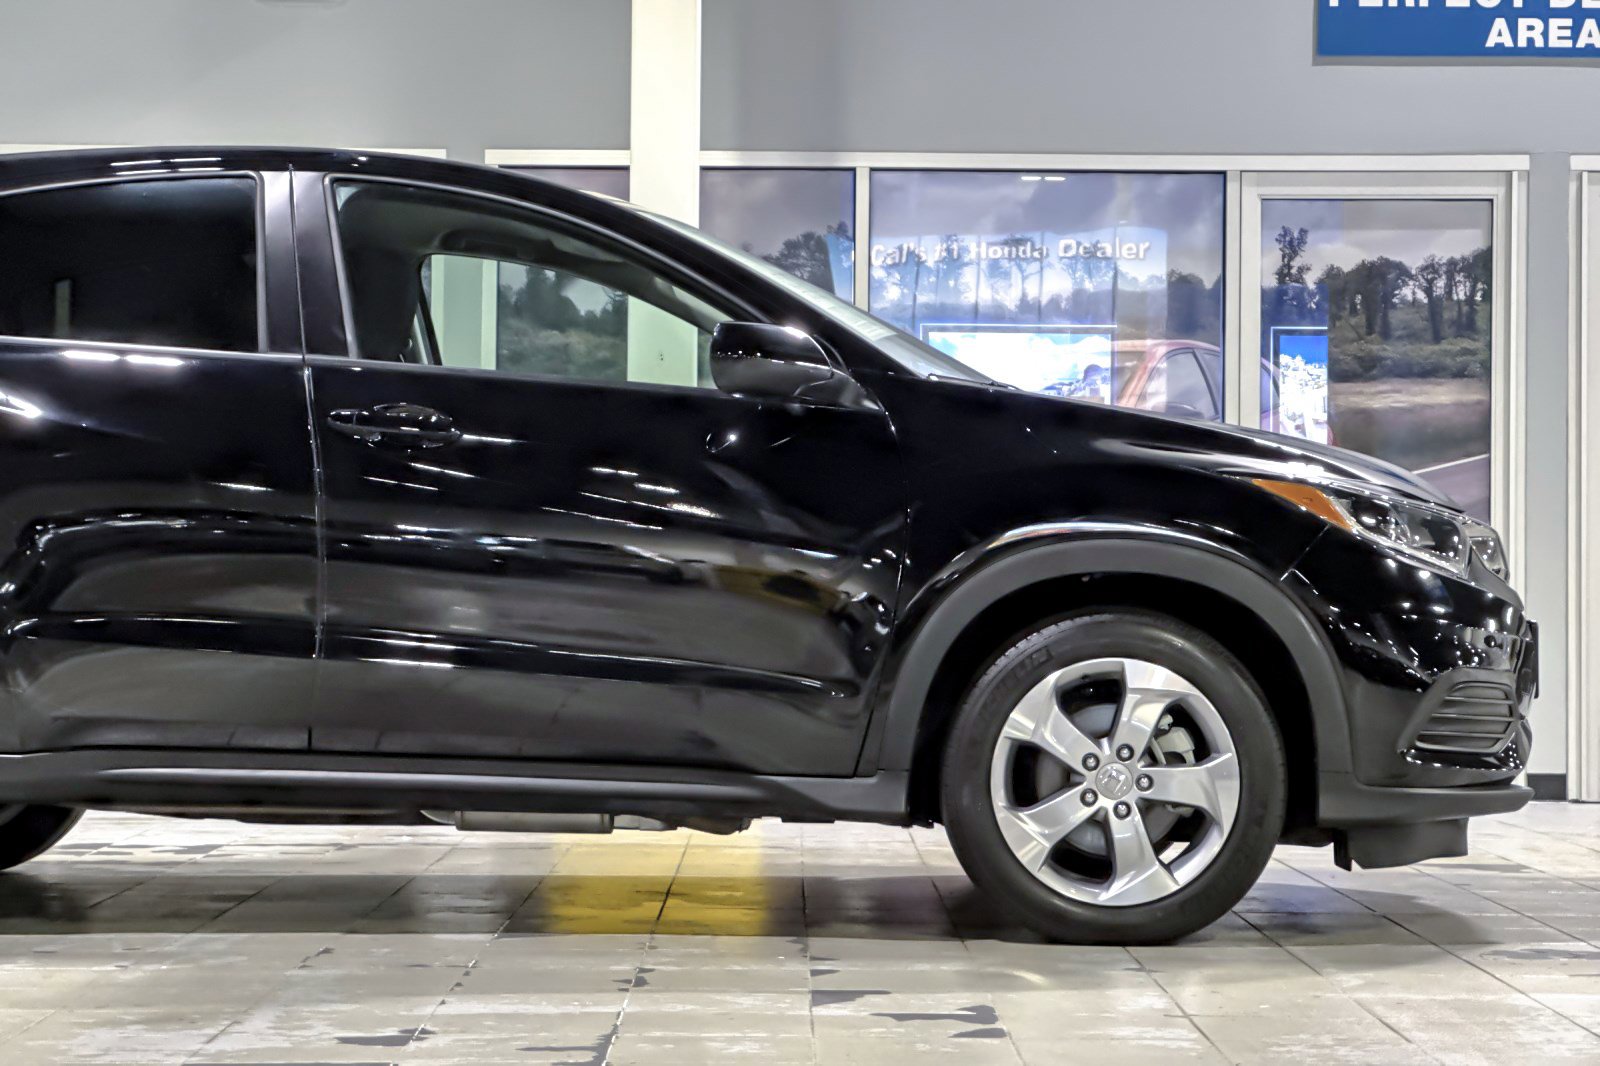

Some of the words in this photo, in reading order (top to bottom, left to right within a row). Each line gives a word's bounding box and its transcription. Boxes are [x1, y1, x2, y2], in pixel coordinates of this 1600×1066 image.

[1485, 17, 1600, 49] AREA
[870, 242, 927, 266] Cal's
[970, 241, 1049, 261] Honda
[1058, 236, 1150, 260] Dealer
